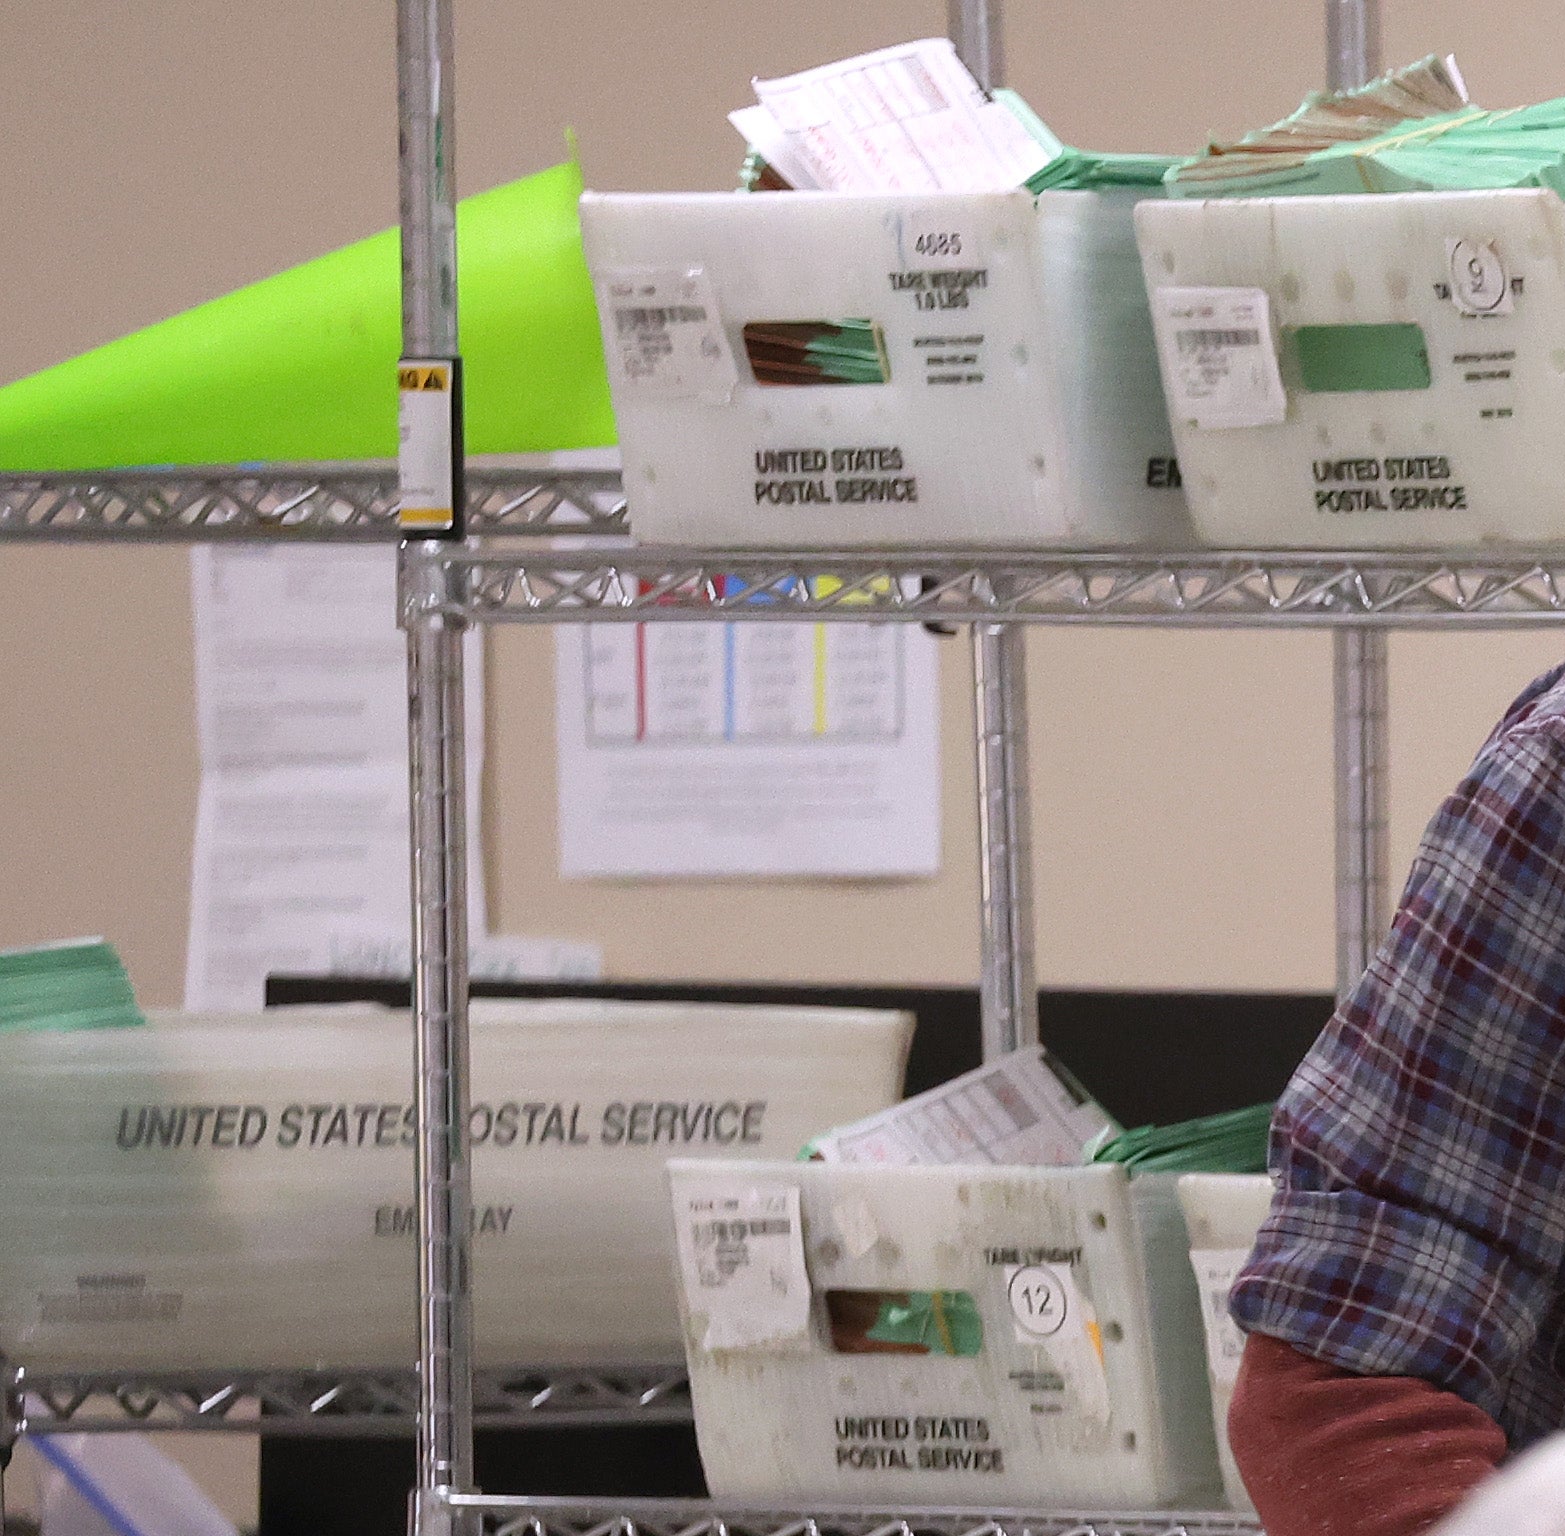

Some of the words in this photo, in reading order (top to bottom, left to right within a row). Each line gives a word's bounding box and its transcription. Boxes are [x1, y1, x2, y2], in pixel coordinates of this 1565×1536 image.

[755, 449, 827, 472] UNITED
[831, 447, 902, 470] STATES
[1313, 459, 1381, 482] UNITED
[1385, 457, 1450, 480] STATES
[755, 479, 831, 503] POSTAL
[835, 477, 918, 501] SERVICE
[1316, 488, 1391, 513] POSTAL
[1396, 486, 1467, 511] SERVICE
[117, 1104, 268, 1149] UNITED
[467, 1103, 590, 1146] OSTAL
[600, 1101, 766, 1143] SERVICE
[374, 1206, 417, 1237] EM
[1021, 1285, 1054, 1316] 12
[836, 1418, 910, 1441] UNITED
[914, 1416, 989, 1440] STATES
[837, 1448, 912, 1471] POSTAL
[919, 1447, 1004, 1473] SERVICE
